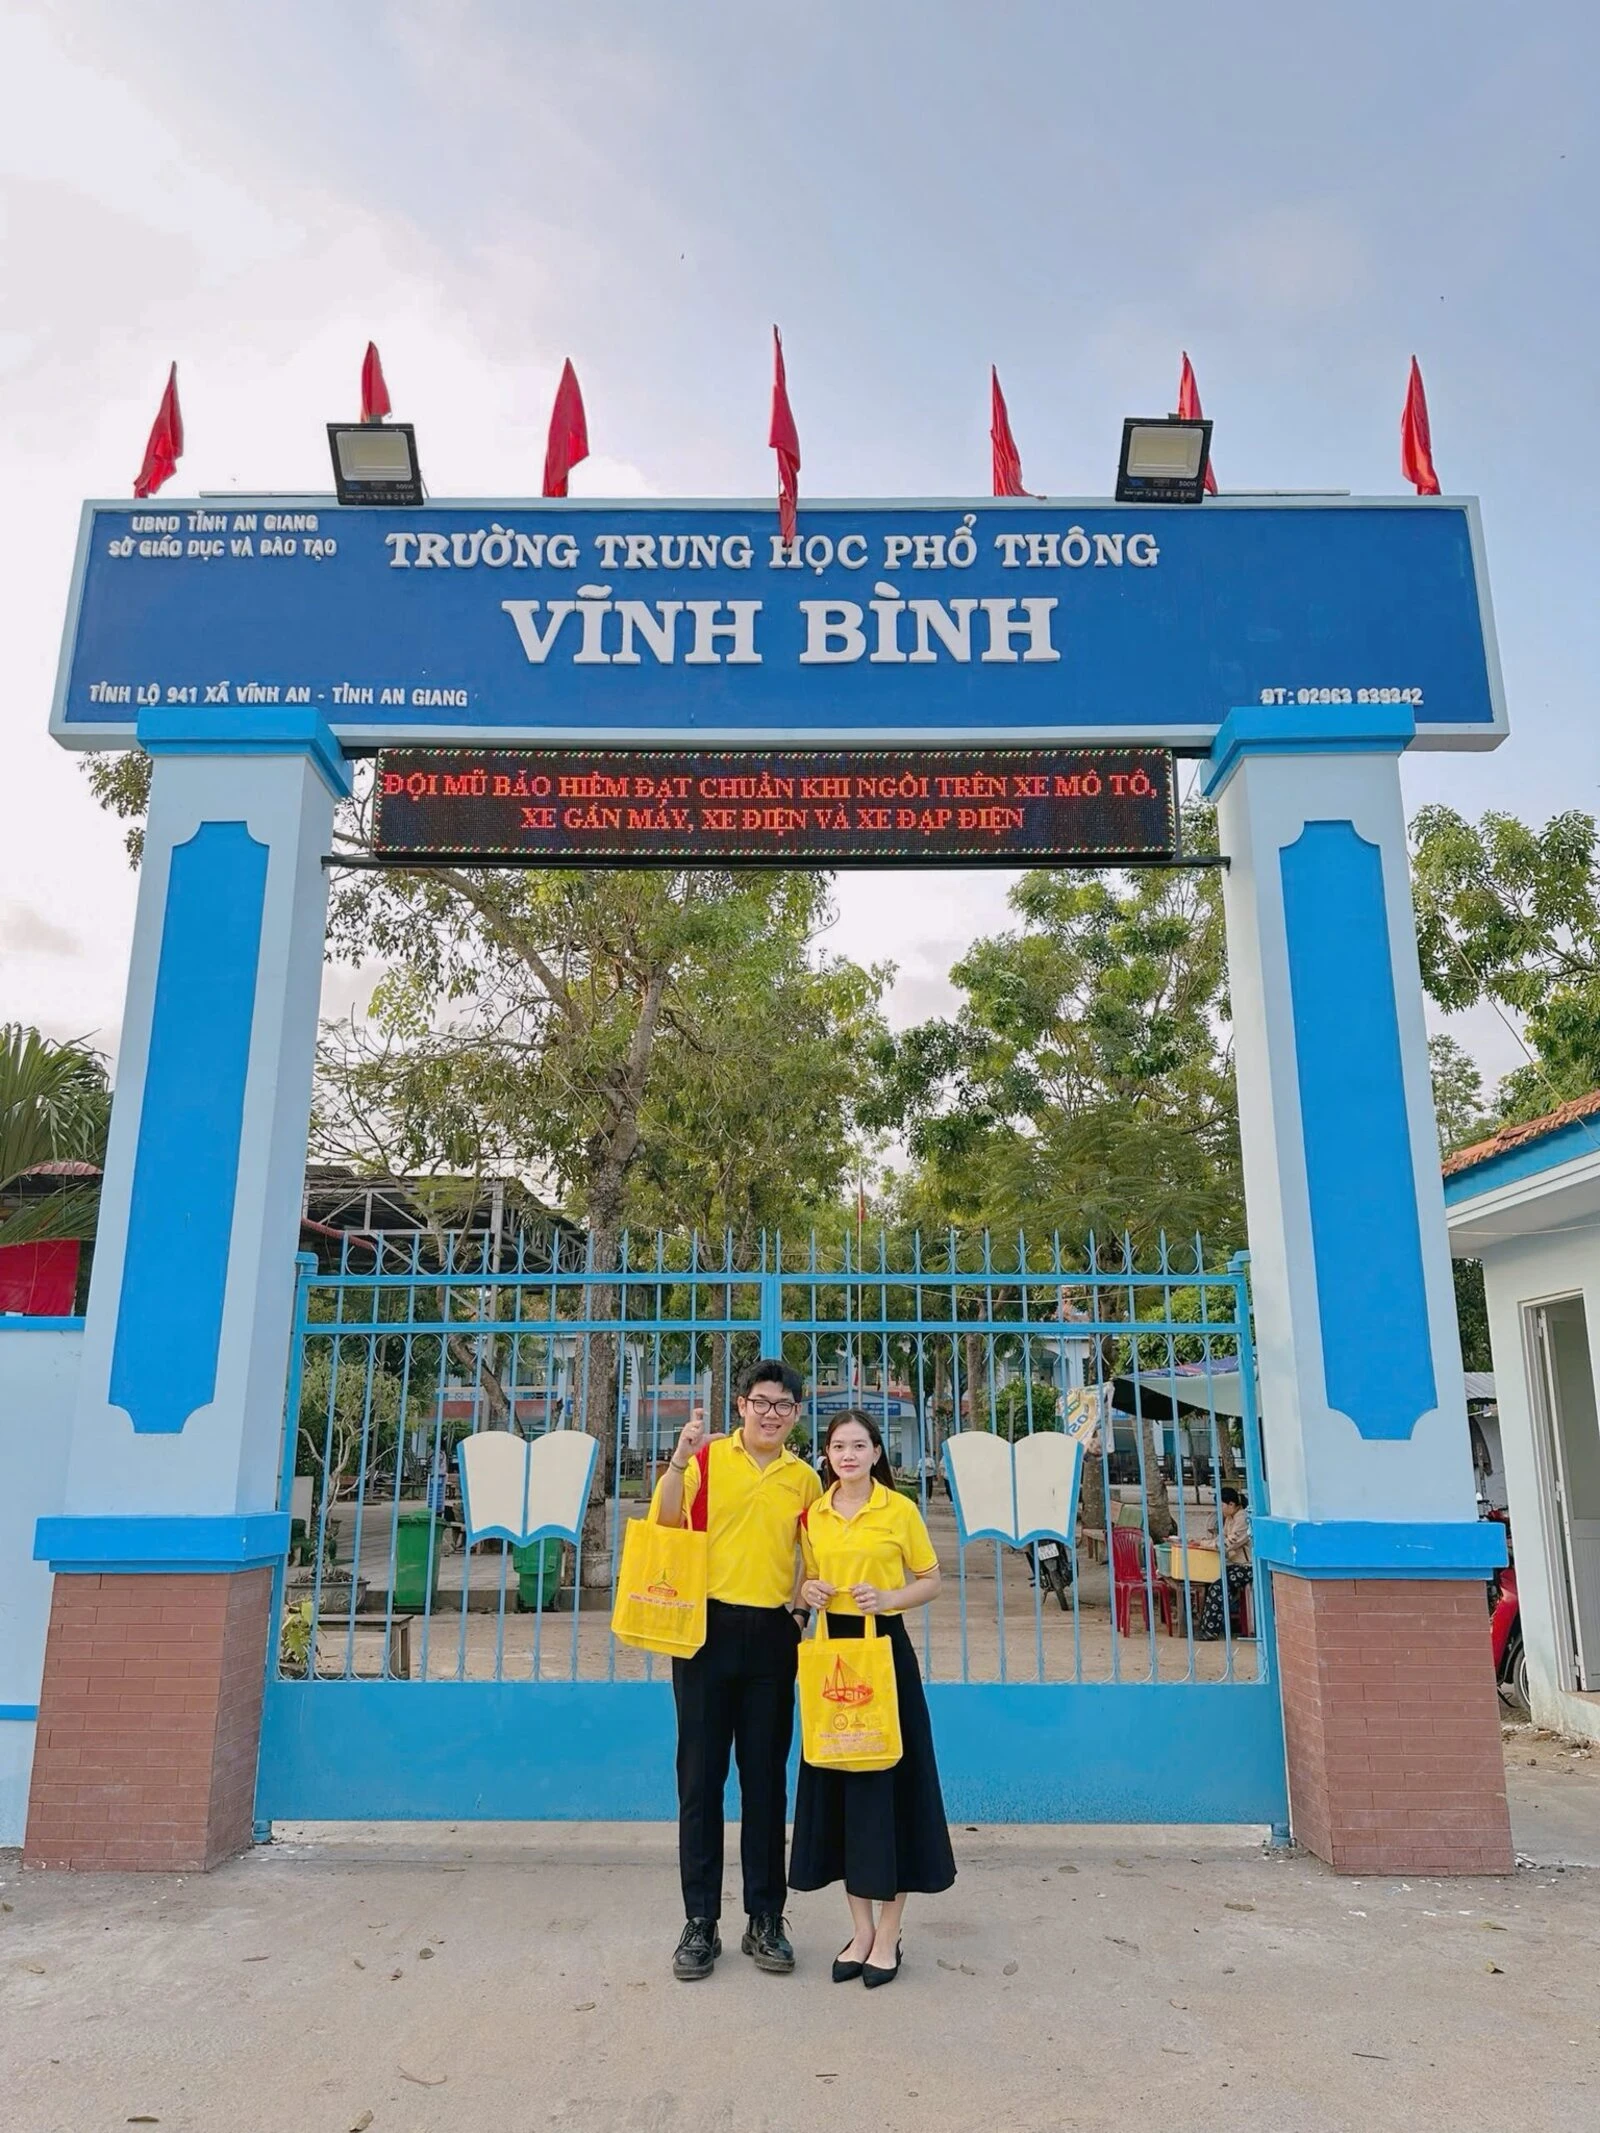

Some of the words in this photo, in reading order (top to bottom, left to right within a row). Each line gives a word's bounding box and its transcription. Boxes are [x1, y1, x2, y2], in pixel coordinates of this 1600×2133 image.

[132, 516, 180, 533] UBND
[187, 510, 227, 532] TỈNH
[233, 514, 257, 532] AN
[263, 514, 318, 532] GIANG
[109, 535, 137, 558] SỞ
[139, 534, 182, 558] GIÁO
[187, 539, 225, 561] DỤC
[230, 535, 254, 557] VÀ
[260, 535, 297, 557] ĐÀO
[303, 539, 337, 561] TẠO
[385, 522, 580, 569] TRƯỜNG
[595, 534, 754, 569] TRUNG
[769, 534, 868, 576] HỌC
[884, 514, 978, 569] PHỔ
[994, 525, 1160, 568] THÔNG
[502, 584, 763, 664] VĨNH
[799, 581, 1061, 664] BÌNH
[90, 681, 131, 703] TỈNH
[137, 683, 160, 706] LỘ
[167, 686, 198, 703] 941
[204, 680, 230, 703] XÃ
[236, 682, 280, 703] VĨNH
[285, 686, 311, 703] AN
[332, 682, 374, 704] TỈNH
[379, 688, 405, 705] AN
[412, 688, 468, 707] GIANG
[383, 772, 438, 801] ĐỘI
[443, 769, 488, 796] MŨ
[493, 769, 551, 797] BẢO
[558, 771, 629, 797] HIỂM
[635, 777, 692, 804] ĐẠT
[700, 771, 795, 798] CHUẨN
[801, 778, 851, 798] KHI
[856, 771, 929, 798] NGỒI
[935, 770, 1007, 798] TRÊN
[1014, 776, 1049, 797] XE
[1054, 769, 1101, 796] MÔ
[1109, 768, 1157, 799] TÔ,
[521, 807, 557, 828] XE
[564, 802, 622, 829] GẮN
[627, 799, 694, 834] MÁY,
[702, 809, 737, 830] XE
[742, 808, 808, 836] ĐIỆN
[814, 802, 851, 829] VÀ
[857, 808, 891, 829] XE
[897, 808, 952, 835] ĐẠP
[958, 806, 1025, 835] ĐIỆN
